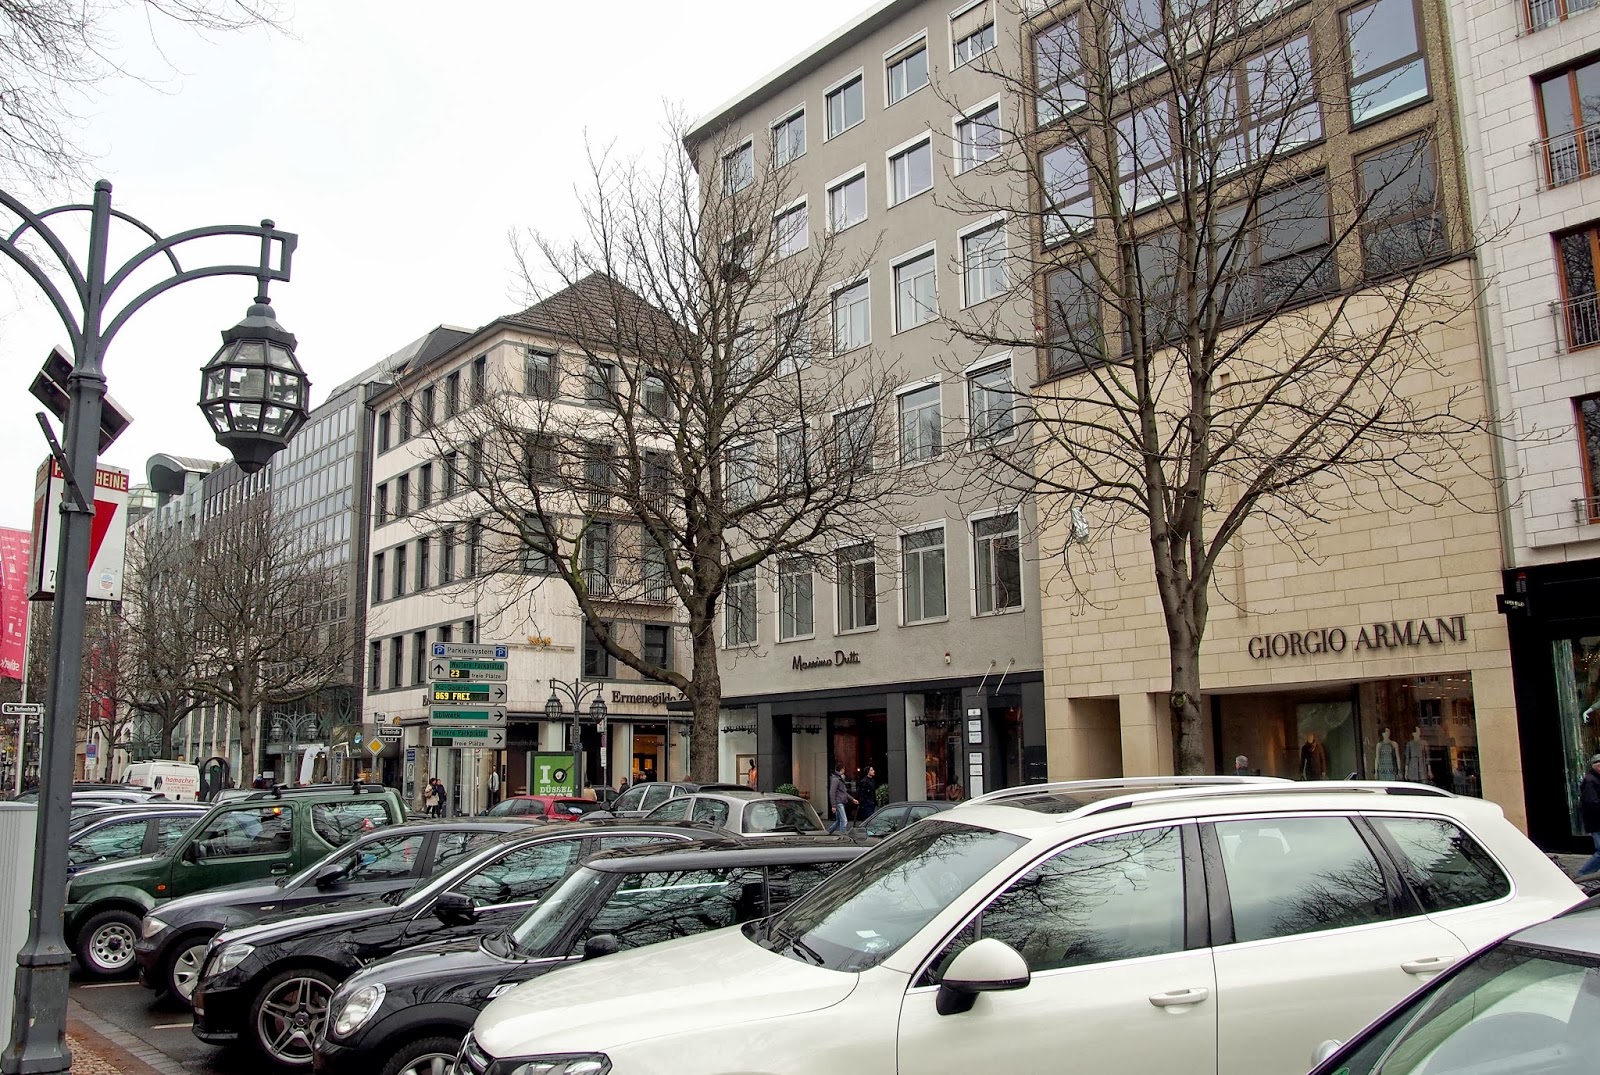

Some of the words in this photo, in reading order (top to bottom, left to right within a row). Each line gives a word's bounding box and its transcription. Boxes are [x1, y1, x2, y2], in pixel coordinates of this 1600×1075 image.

[1248, 627, 1347, 659] GIORGIO
[1354, 616, 1467, 650] ARMANI
[447, 647, 494, 655] Parkleitsystem
[792, 654, 833, 671] Massimo
[834, 650, 861, 666] Dutti
[435, 692, 449, 700] 869
[540, 765, 551, 784] I
[540, 785, 573, 793] DÜSSEL
